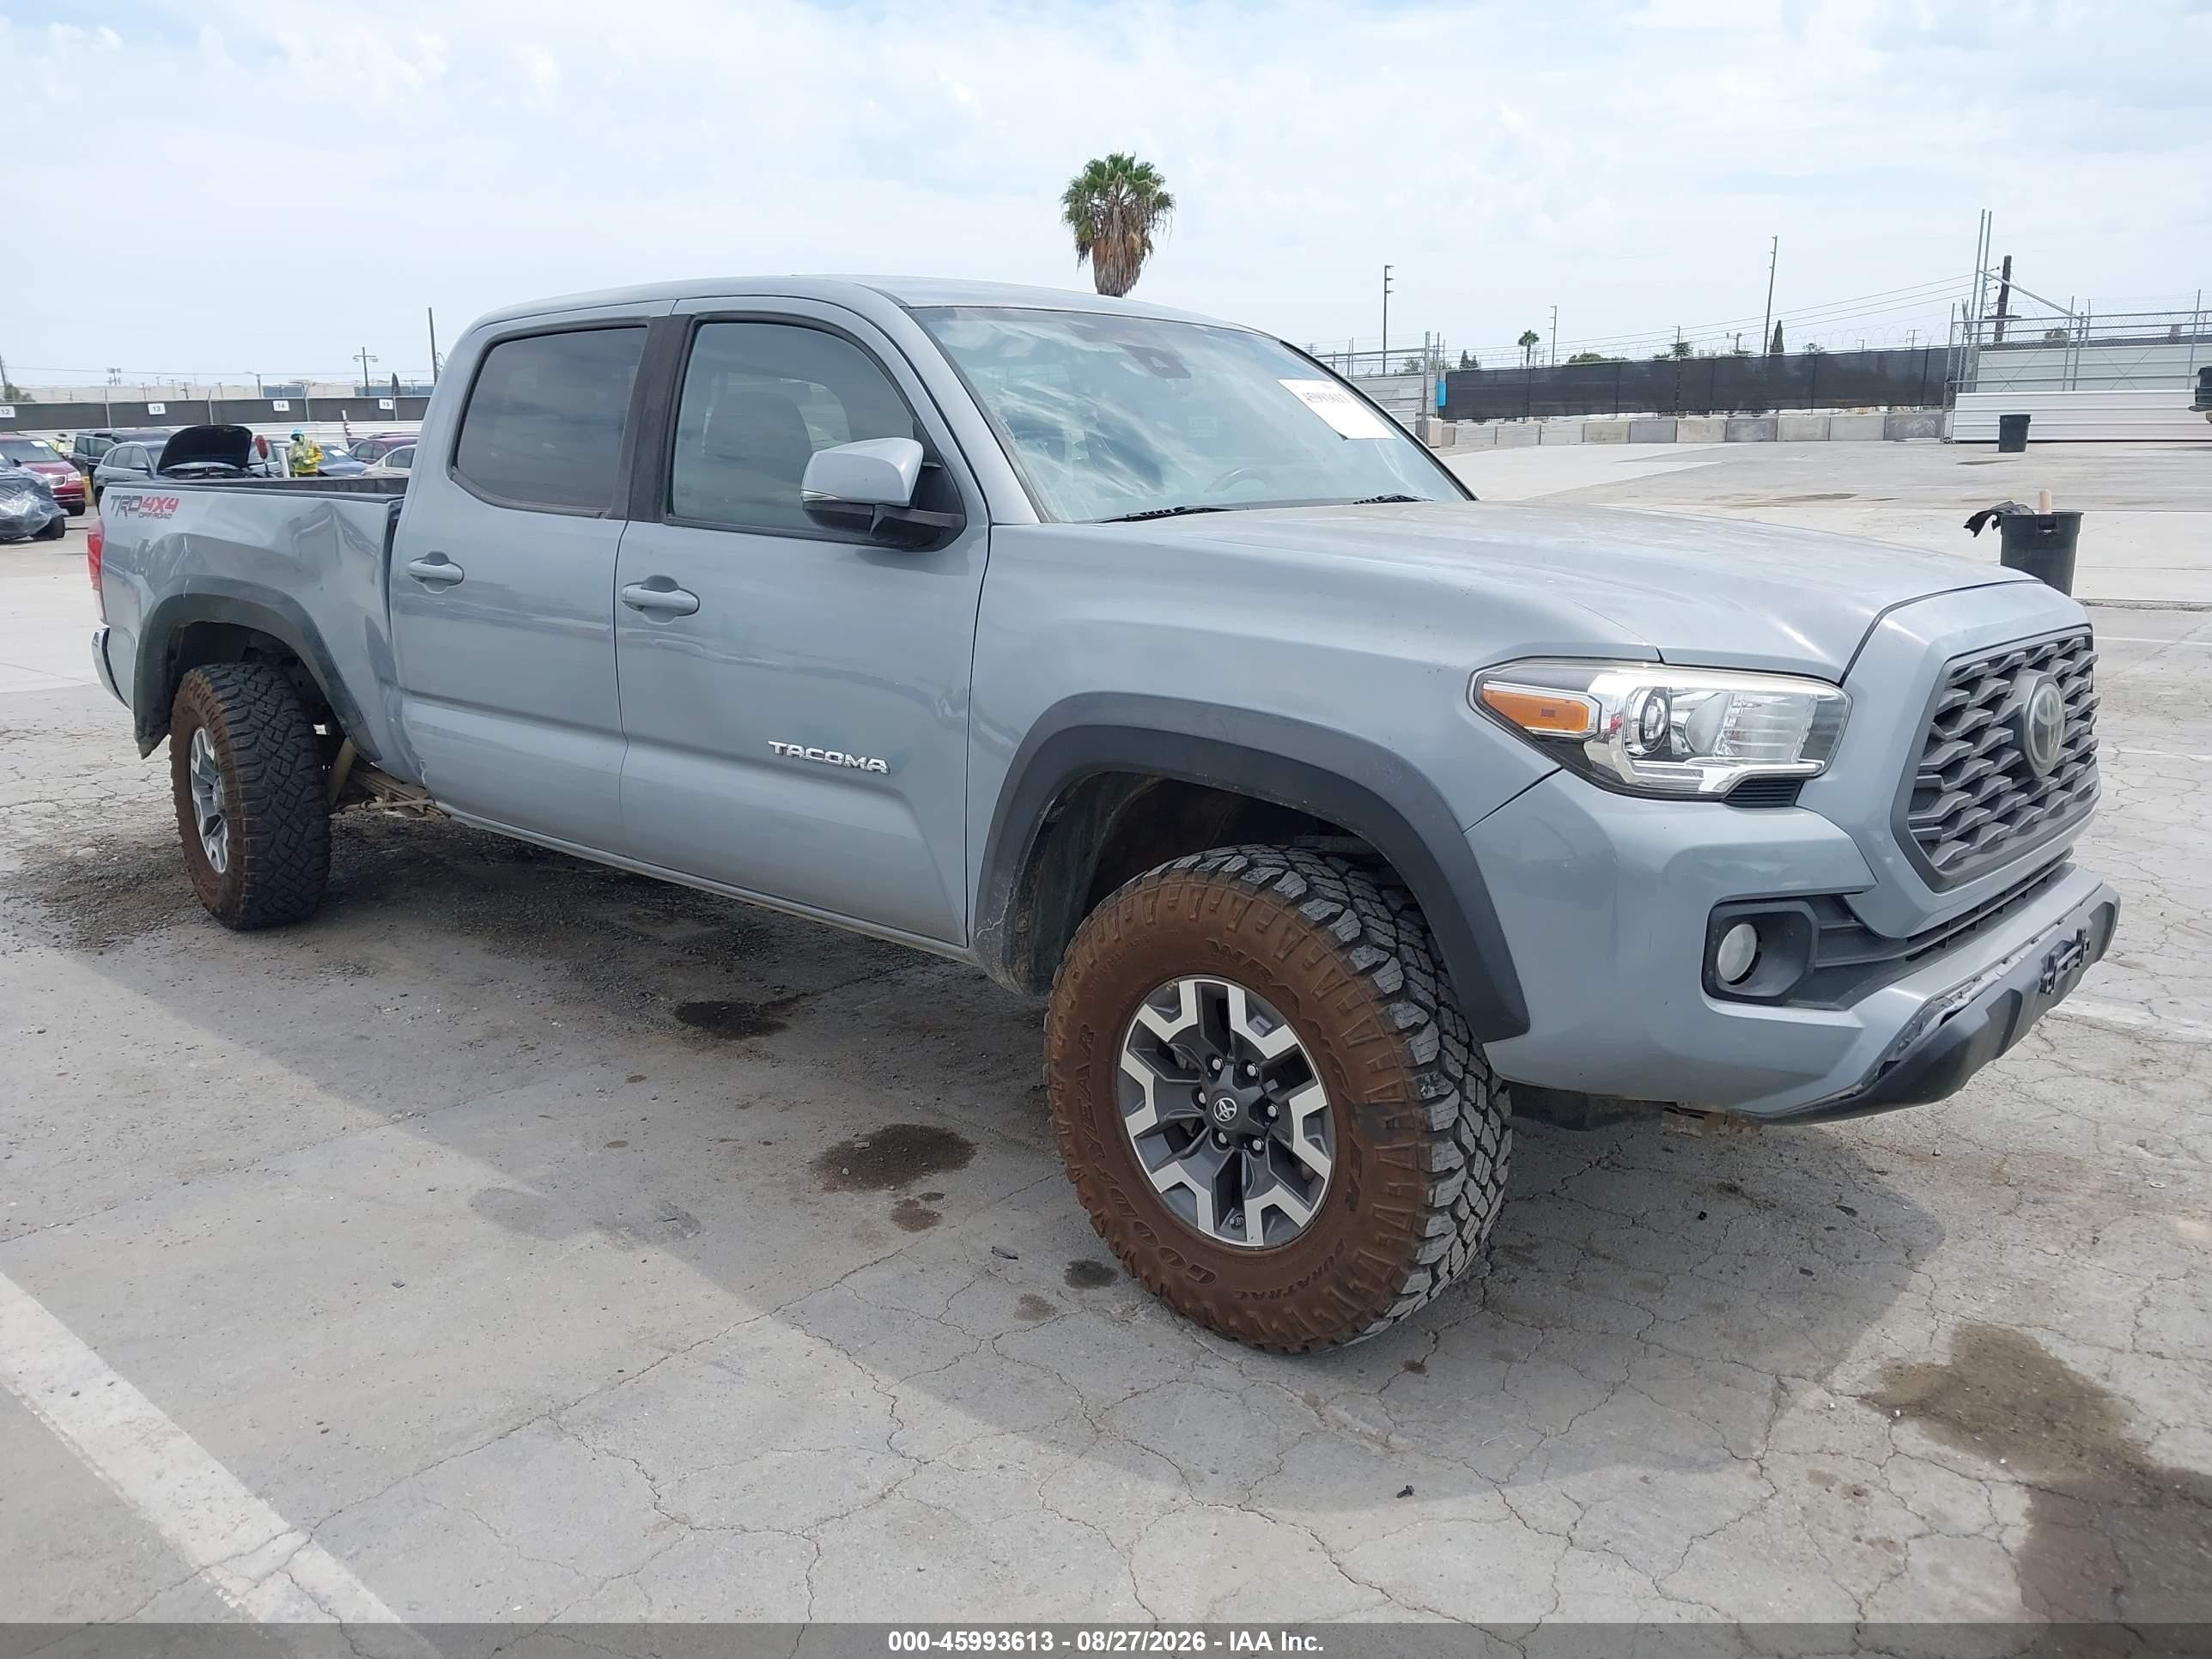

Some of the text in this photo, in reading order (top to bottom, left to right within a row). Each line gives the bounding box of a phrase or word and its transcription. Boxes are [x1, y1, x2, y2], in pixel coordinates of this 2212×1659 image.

[110, 495, 143, 517] TRD
[767, 740, 890, 774] TACOMA
[1075, 1023, 1218, 1286] GOODYEAR
